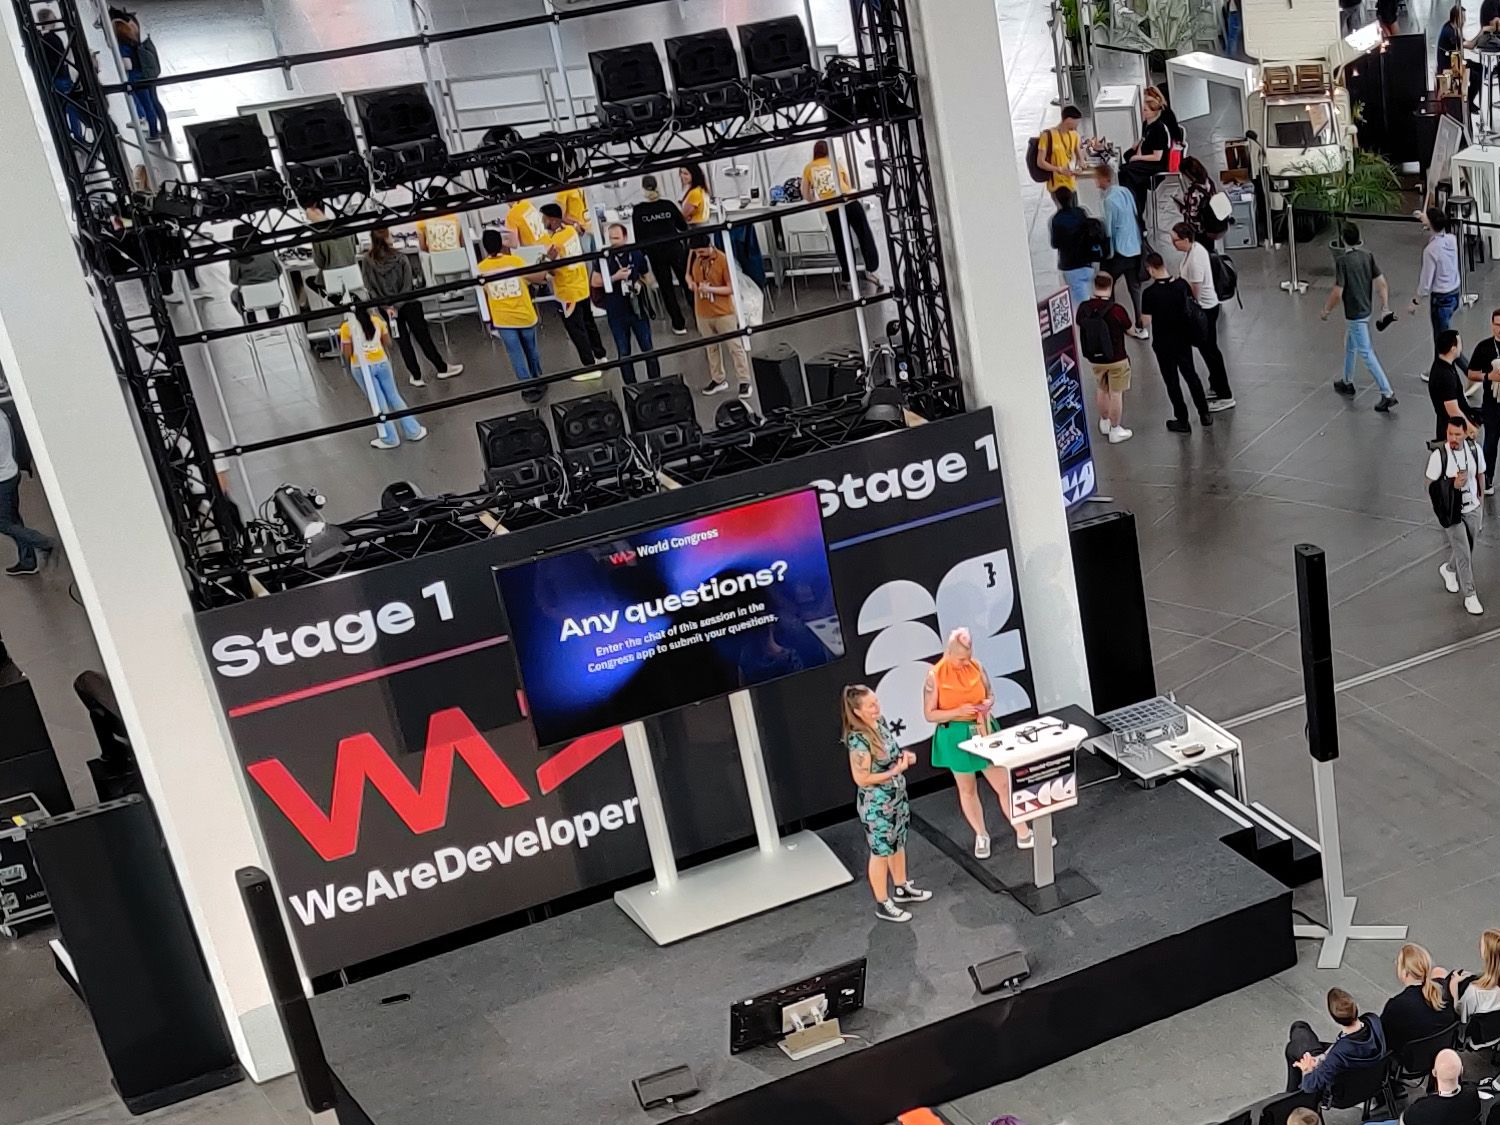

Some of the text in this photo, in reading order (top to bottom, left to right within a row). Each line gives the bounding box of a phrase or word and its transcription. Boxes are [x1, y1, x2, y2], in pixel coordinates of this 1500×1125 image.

[808, 433, 999, 518] Stage 1
[637, 528, 719, 558] World Congress
[211, 580, 454, 678] Stage 1
[559, 560, 789, 643] Any questions?
[595, 602, 766, 658] Enter the chat of this session in the
[587, 655, 635, 674] Congress
[636, 648, 656, 663] app
[657, 643, 668, 656] to
[669, 633, 704, 652] submit
[704, 627, 728, 643] your
[288, 797, 640, 926] WeAreDeveloper
